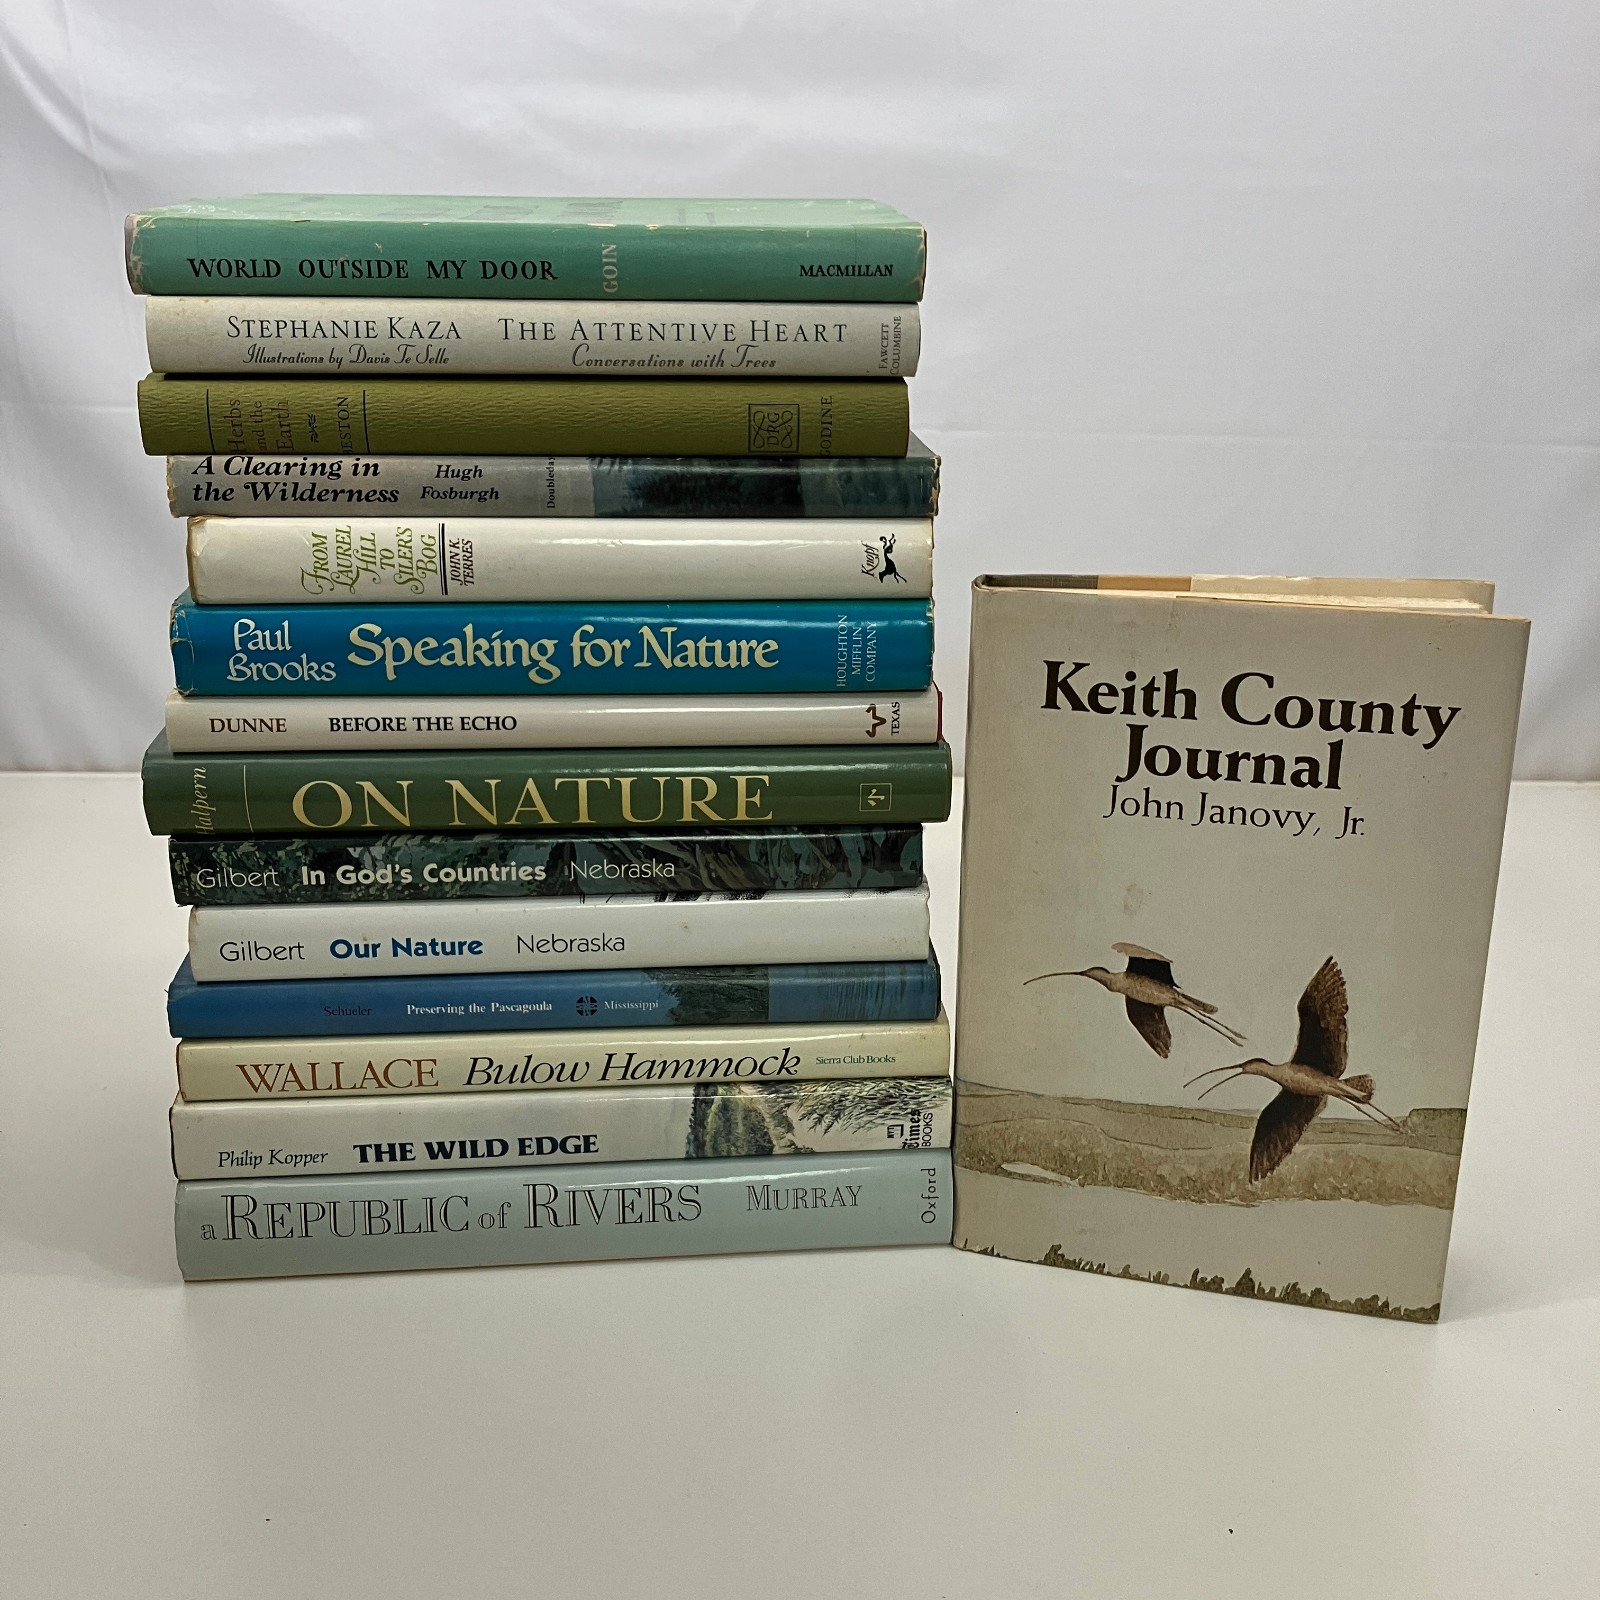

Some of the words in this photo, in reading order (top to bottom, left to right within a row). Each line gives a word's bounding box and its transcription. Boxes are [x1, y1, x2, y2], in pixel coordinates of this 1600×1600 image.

[187, 258, 282, 279] WORLD
[299, 259, 409, 279] OUTSIDE
[427, 260, 467, 279] MY
[481, 260, 559, 281] DOOR
[602, 243, 619, 293] GOIN
[800, 264, 893, 278] MACMILLAN
[227, 315, 378, 340] STEPHANIE
[388, 316, 462, 340] KAZA
[498, 318, 556, 341] THE
[570, 318, 736, 343] ATTENTIVE
[749, 319, 848, 343] HEART
[242, 343, 325, 365] Illustrations
[329, 347, 344, 368] by
[348, 344, 390, 365] Davis
[394, 344, 411, 365] Te
[415, 344, 449, 365] Selle
[572, 343, 684, 369] Conversations
[690, 348, 725, 368] with
[730, 344, 777, 369] Trees
[879, 323, 889, 369] FAWCETT
[890, 315, 902, 376] COLUMBINE
[224, 399, 247, 454] Herbs
[250, 400, 264, 423] the
[271, 400, 295, 451] Earth
[252, 429, 268, 452] and
[191, 456, 215, 475] A
[224, 456, 343, 481] Clearing
[352, 457, 381, 476] in
[435, 464, 484, 482] Hugh
[546, 457, 555, 508] Doubleday
[193, 482, 235, 501] the
[243, 482, 400, 503] Wilderness
[420, 486, 500, 502] Fosburgh
[330, 525, 360, 595] LAUREL
[353, 532, 381, 585] HILL
[379, 548, 396, 571] TO
[393, 526, 425, 595] SILER'S
[415, 534, 438, 579] BOG
[448, 538, 461, 550] K.
[861, 541, 879, 578] Knopf
[300, 532, 335, 595] FROM
[448, 551, 464, 586] JOHN
[461, 538, 475, 587] TERRES
[233, 618, 292, 651] Paul
[836, 614, 848, 687] HOUGHTON
[852, 626, 863, 675] MIFFLIN
[226, 653, 337, 682] Brooks
[347, 623, 561, 685] Speaking
[570, 624, 630, 668] for
[634, 625, 779, 669] Nature
[865, 621, 877, 682] COMPANY
[890, 701, 900, 736] TEXAS
[1040, 659, 1197, 721] Keith
[1221, 671, 1462, 750] County
[209, 718, 287, 733] DUNNE
[329, 717, 407, 732] BEFORE
[412, 716, 455, 732] THE
[459, 715, 518, 731] ECHO
[1115, 724, 1343, 791] Journal
[191, 766, 216, 834] Halpern
[292, 780, 413, 828] ON
[445, 775, 773, 826] NATURE
[1102, 785, 1185, 822] John
[1191, 792, 1322, 838] Janovy,
[1335, 807, 1366, 840] Jr.
[197, 867, 280, 888] Gilbert
[302, 865, 325, 885] In
[336, 864, 412, 885] God's
[423, 861, 546, 884] Countries
[569, 858, 675, 881] Nebraska
[219, 941, 305, 962] Gilbert
[329, 938, 381, 959] Our
[391, 937, 484, 957] Nature
[517, 932, 625, 954] Nebraska
[323, 1005, 372, 1017] Schueler
[407, 1004, 464, 1016] Preserving
[469, 1003, 486, 1013] the
[491, 1001, 552, 1013] Pascagoula
[604, 1000, 659, 1011] Mississippi
[236, 1058, 439, 1093] WALLACE
[462, 1054, 589, 1086] Bulow
[597, 1047, 801, 1082] Hammock
[815, 1055, 842, 1065] Sierra
[842, 1055, 865, 1064] Club
[866, 1053, 896, 1064] Books
[902, 1109, 921, 1149] Times
[921, 1112, 933, 1147] BOOKS
[218, 1150, 263, 1169] Philip
[268, 1149, 328, 1169] Kopper
[353, 1142, 416, 1164] THE
[425, 1138, 514, 1160] WILD
[518, 1134, 600, 1157] EDGE
[200, 1222, 216, 1241] a
[220, 1194, 470, 1241] REPUBLIC
[478, 1201, 512, 1230] of
[523, 1182, 702, 1229] RIVERS
[746, 1184, 863, 1212] MURRAY
[920, 1167, 939, 1224] Oxford
